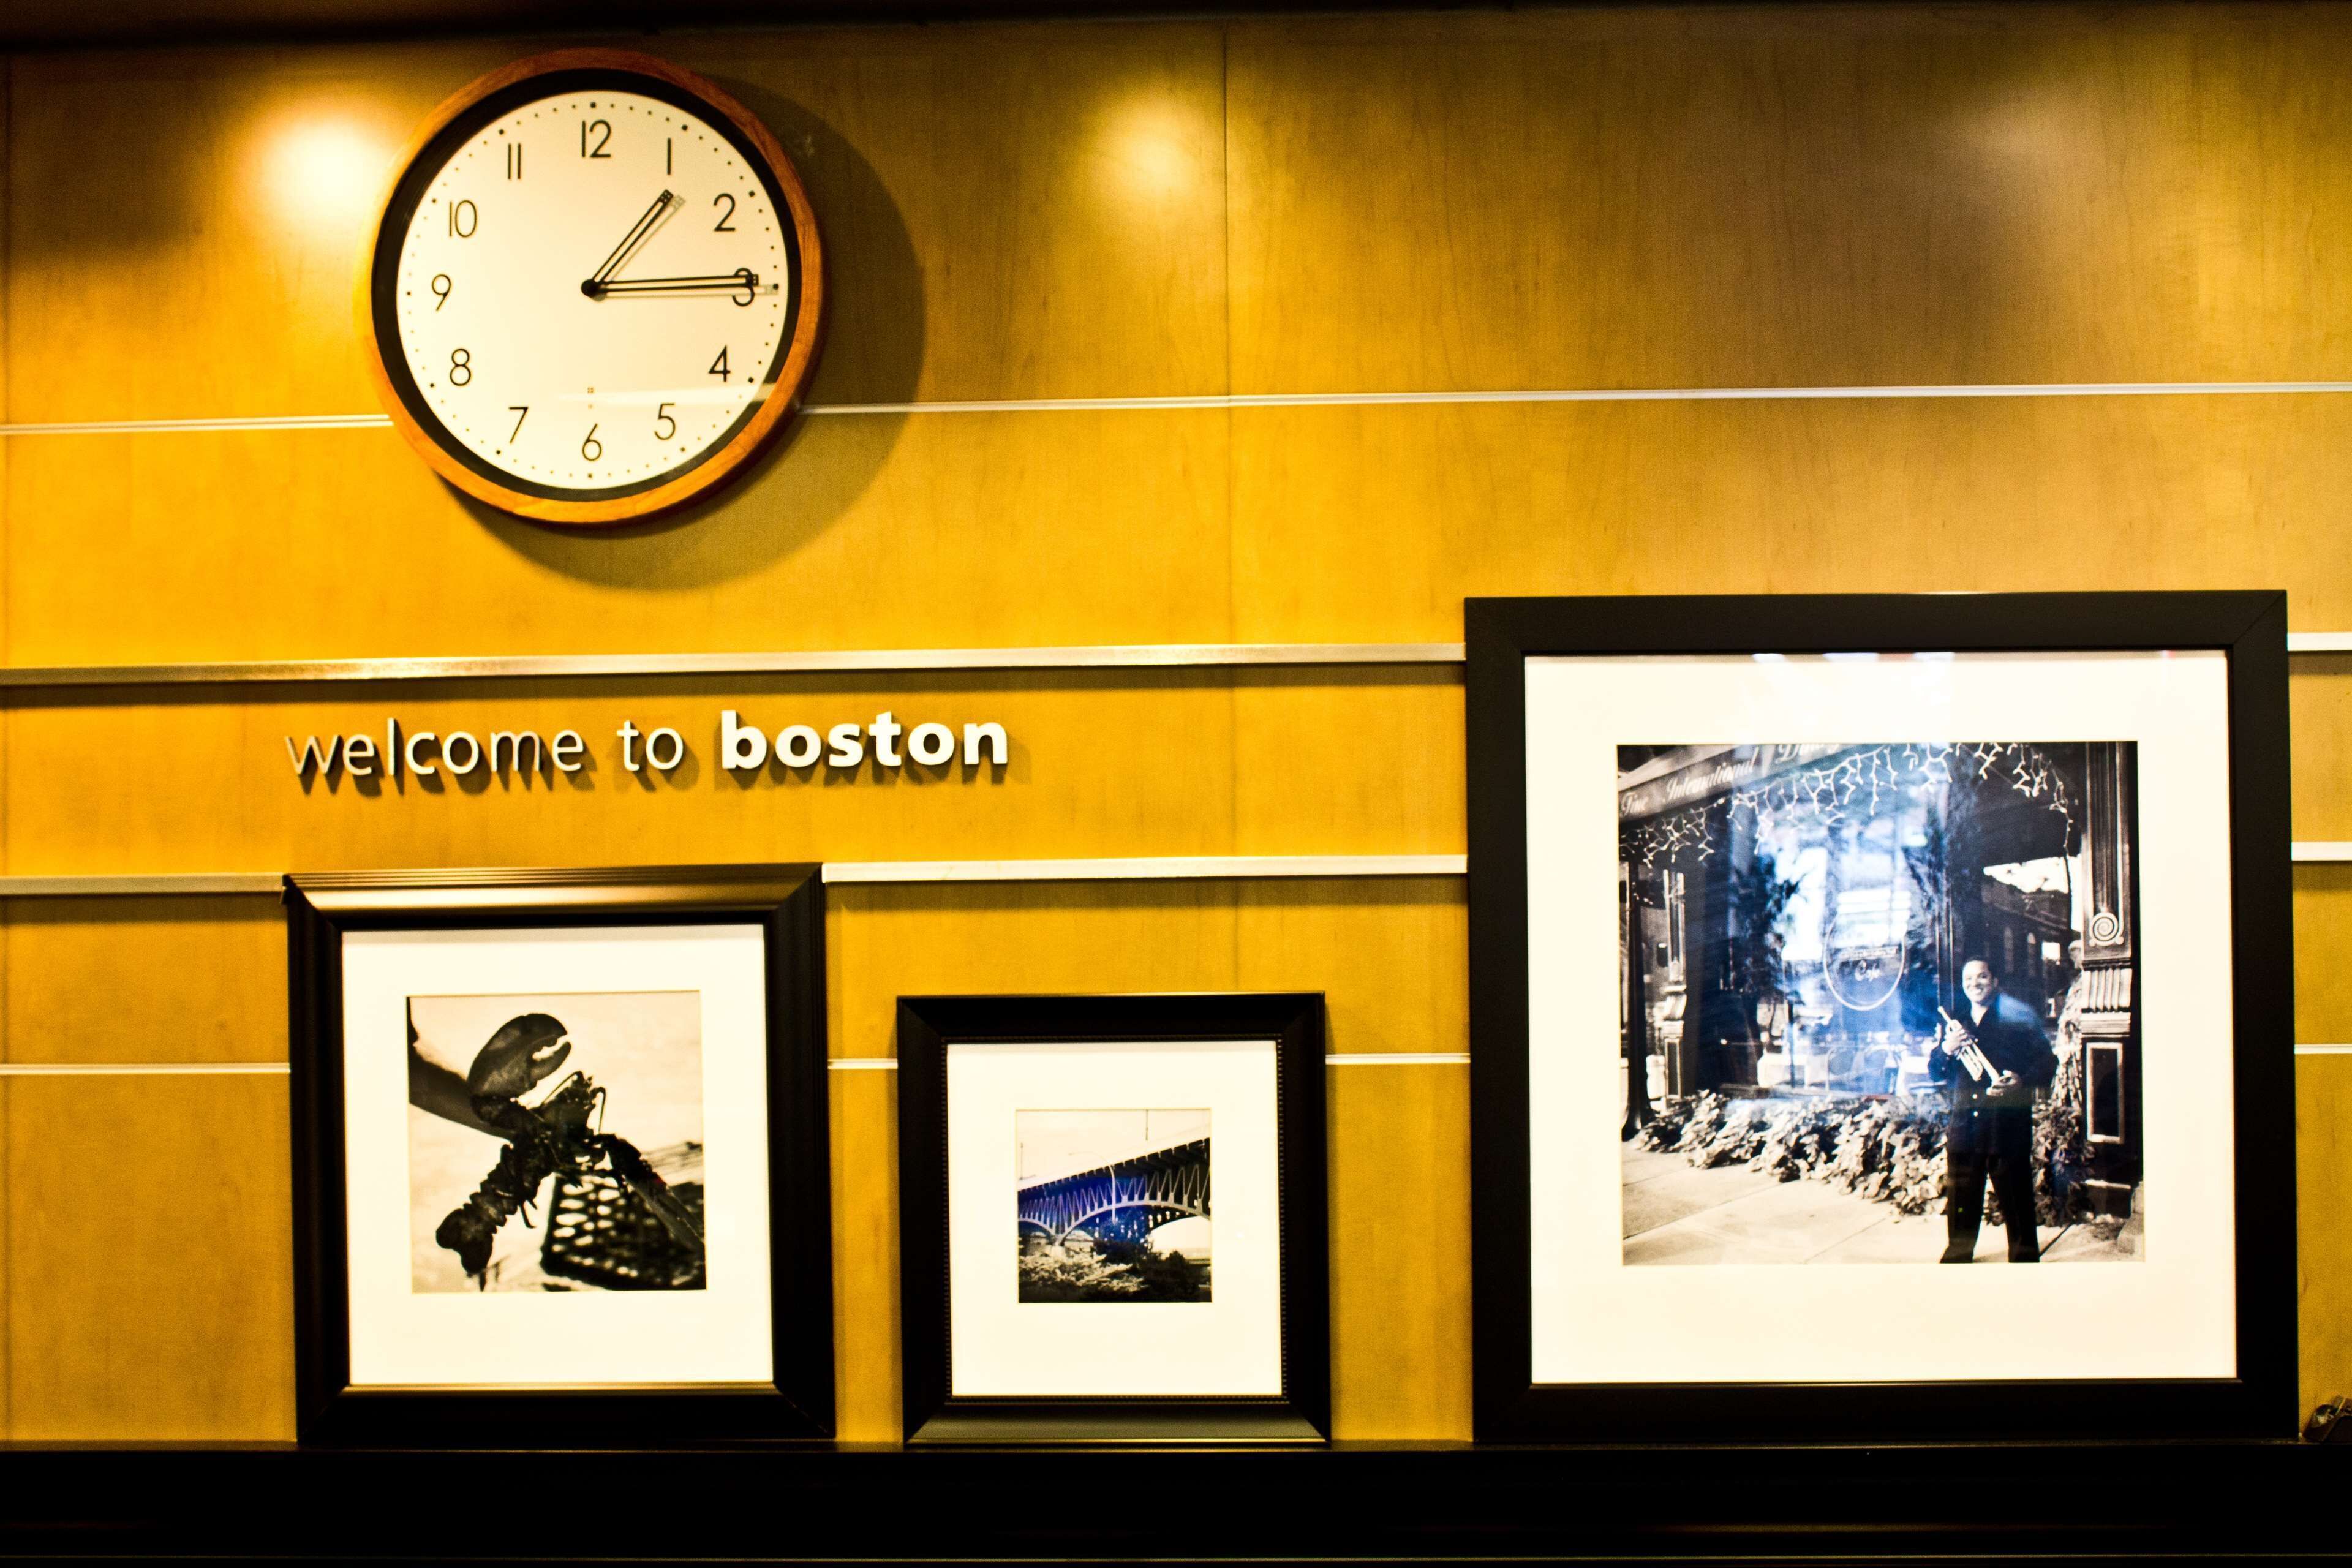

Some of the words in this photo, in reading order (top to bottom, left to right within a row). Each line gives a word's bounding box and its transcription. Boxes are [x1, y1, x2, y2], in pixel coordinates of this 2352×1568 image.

[581, 119, 612, 159] 12
[666, 137, 673, 176] 1
[507, 143, 522, 180] 11
[449, 199, 477, 238] 10
[713, 193, 736, 232] 2
[431, 274, 451, 311] 9
[733, 267, 755, 307] 3
[449, 348, 472, 386] 8
[708, 345, 731, 383] 4
[508, 406, 529, 443] 7
[654, 402, 676, 440] 5
[581, 423, 603, 461] 6
[287, 718, 584, 777] welcome
[616, 720, 684, 772] to
[721, 710, 1008, 769] boston
